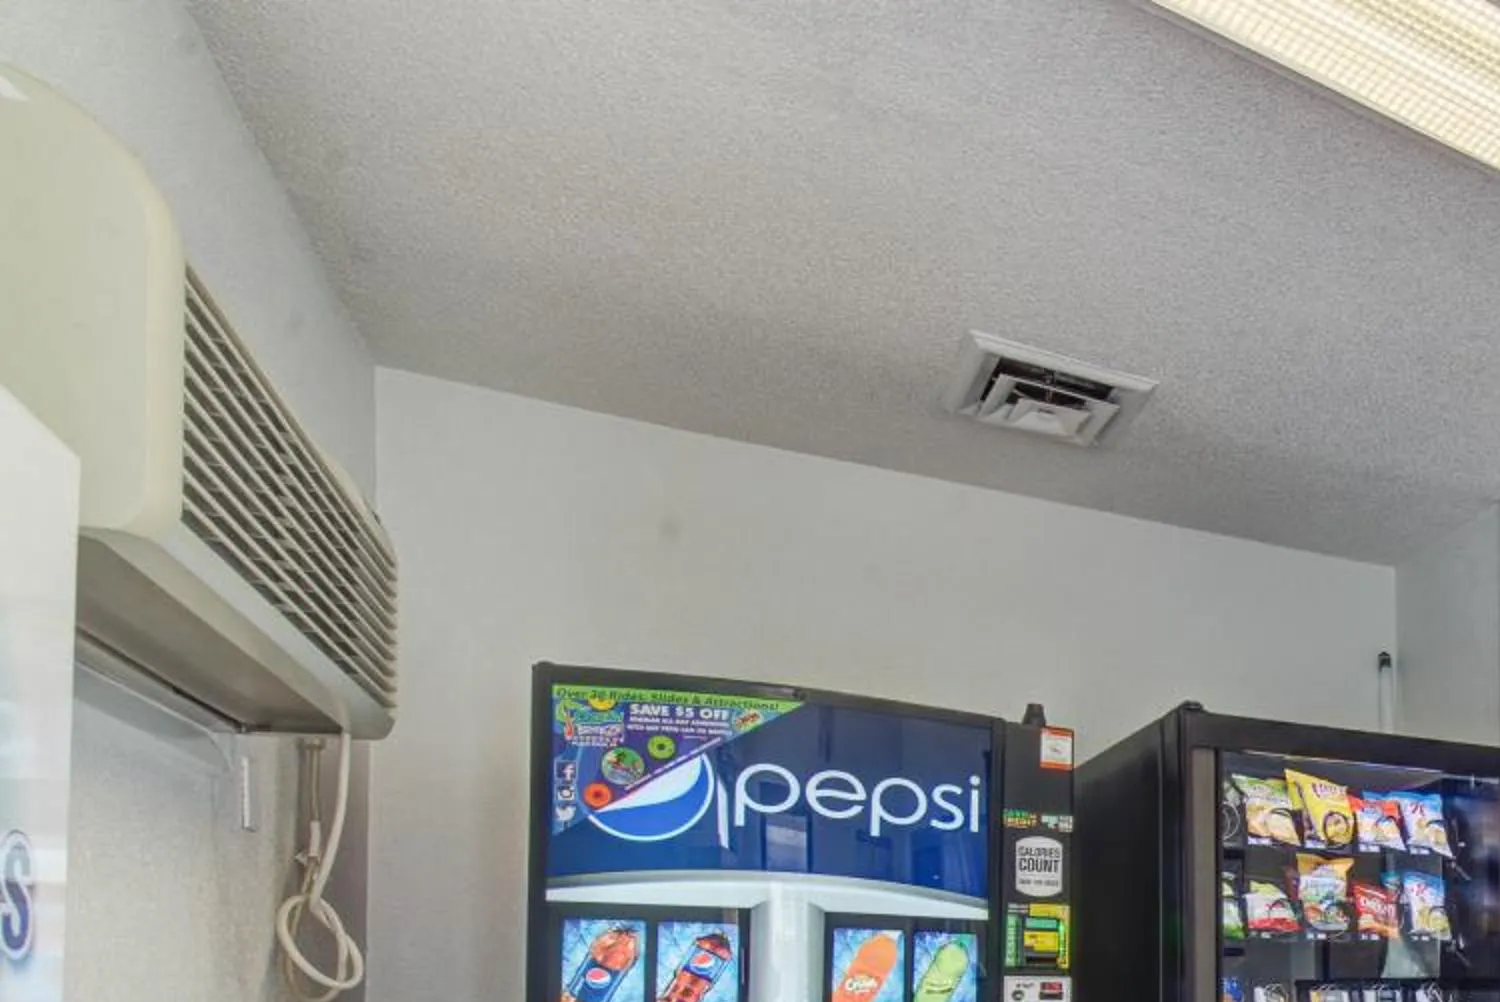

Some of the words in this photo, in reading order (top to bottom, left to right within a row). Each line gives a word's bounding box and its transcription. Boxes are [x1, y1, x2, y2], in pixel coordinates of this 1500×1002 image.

[630, 704, 670, 717] SAVE
[675, 706, 694, 718] $5
[700, 708, 729, 720] OFF
[734, 763, 981, 838] pepsi
[1018, 846, 1060, 859] CALORIES
[1018, 857, 1060, 873] COUNT
